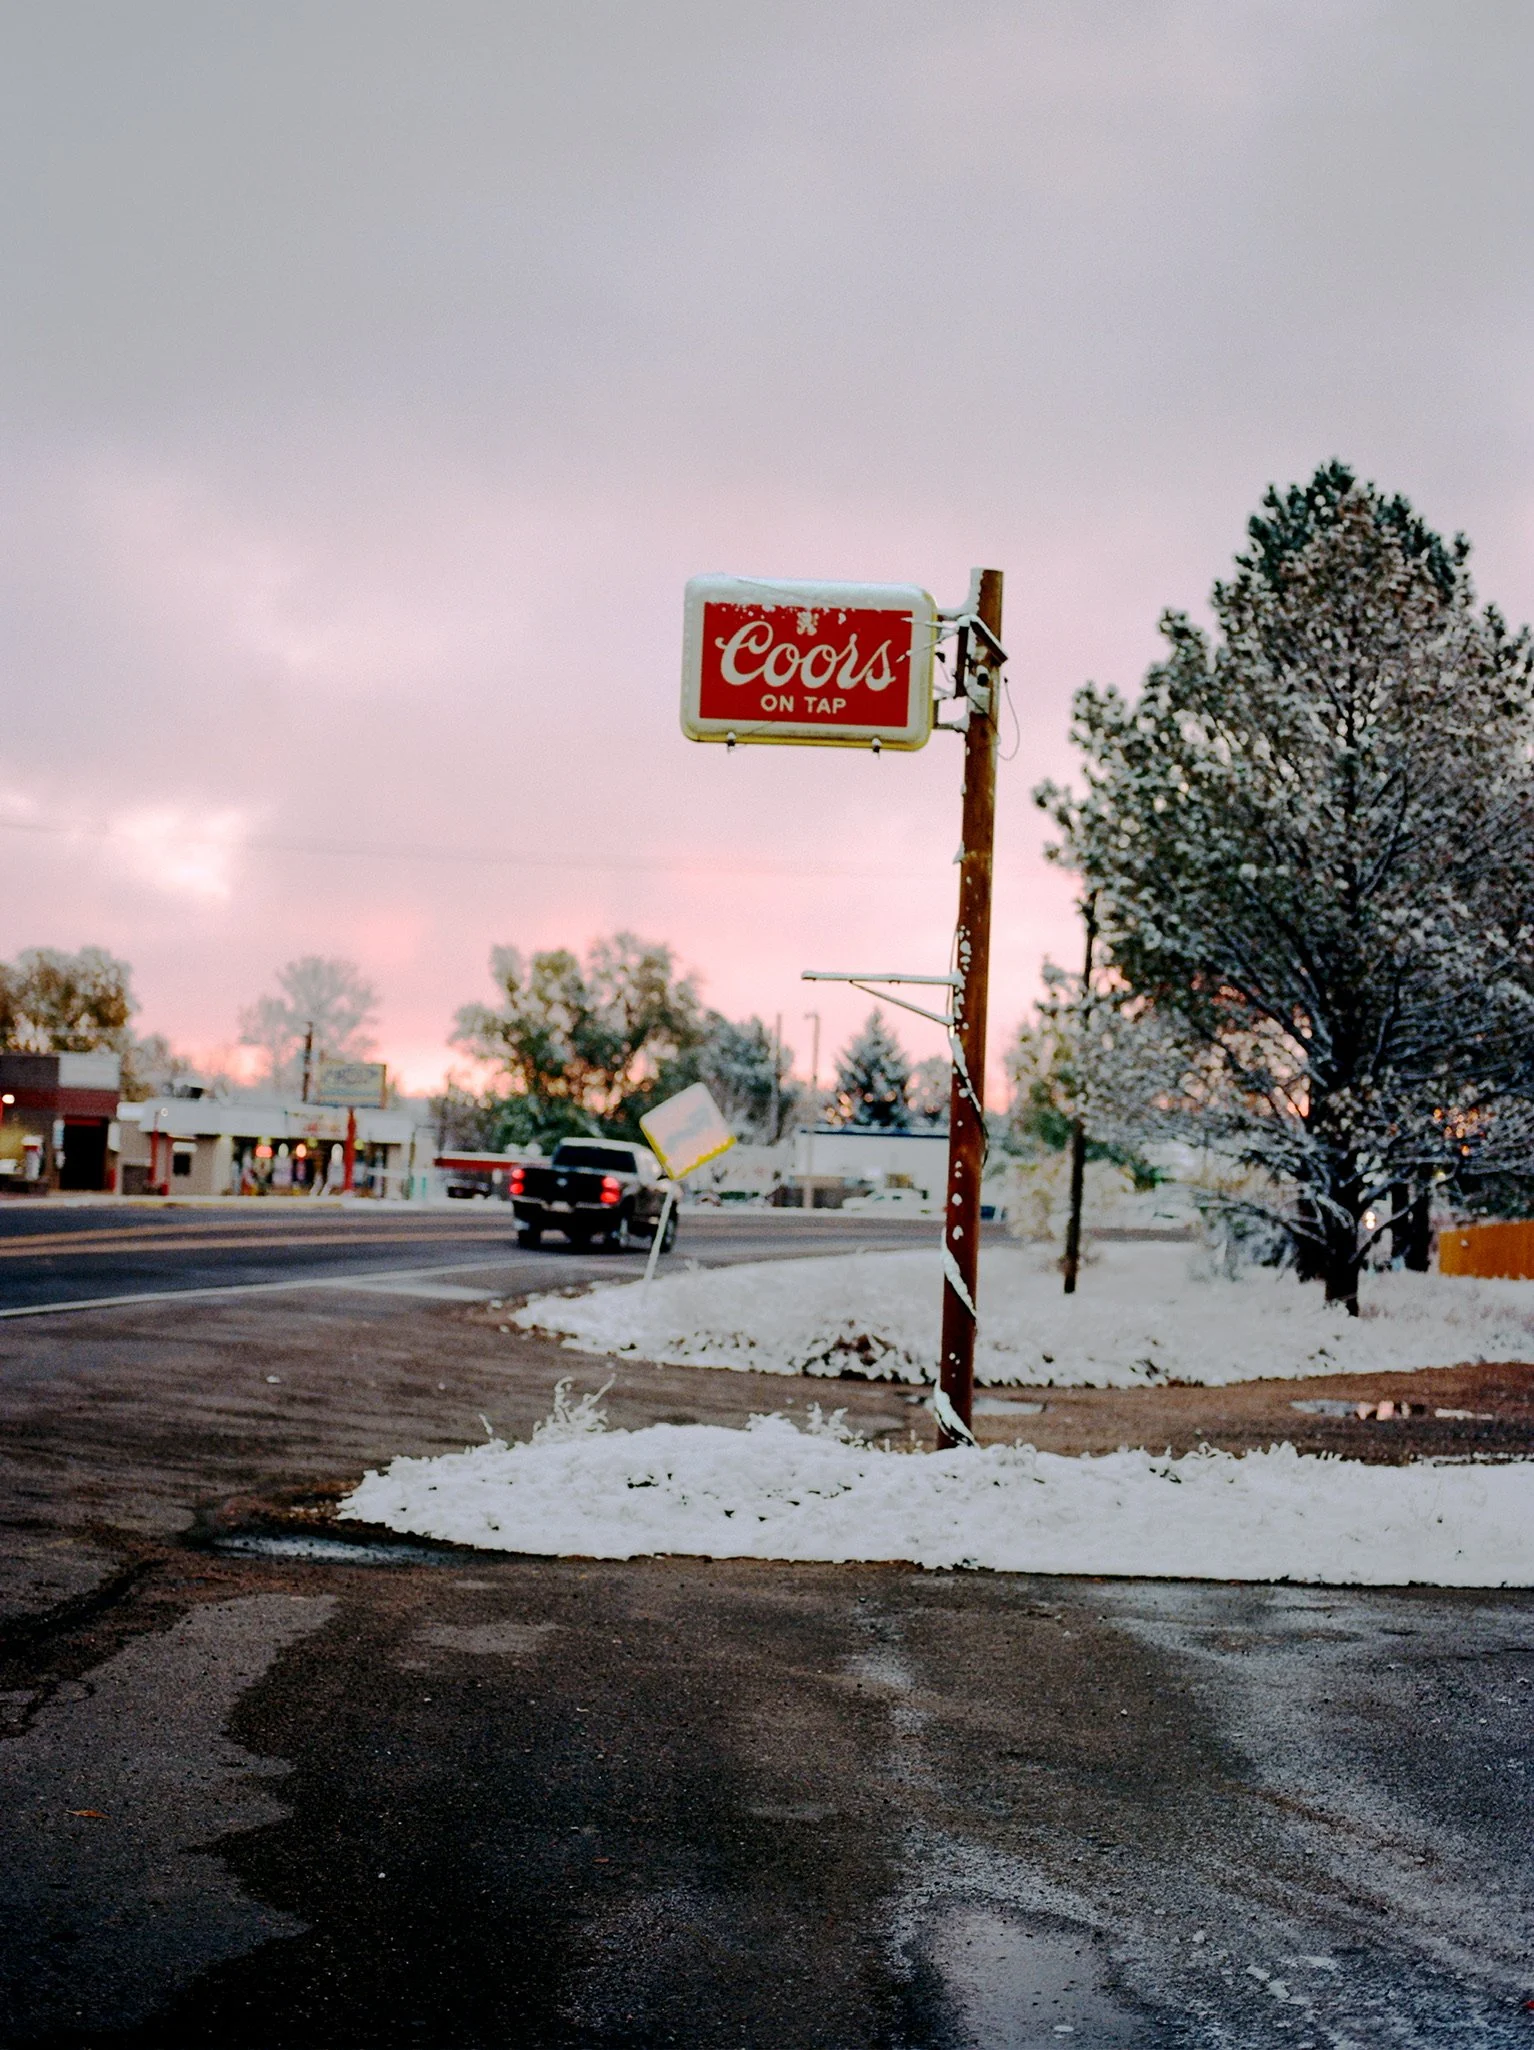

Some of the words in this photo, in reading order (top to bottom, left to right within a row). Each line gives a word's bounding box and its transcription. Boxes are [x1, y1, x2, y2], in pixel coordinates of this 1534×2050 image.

[715, 621, 896, 691] Coors
[760, 694, 794, 712] ON
[803, 696, 847, 714] TAP
